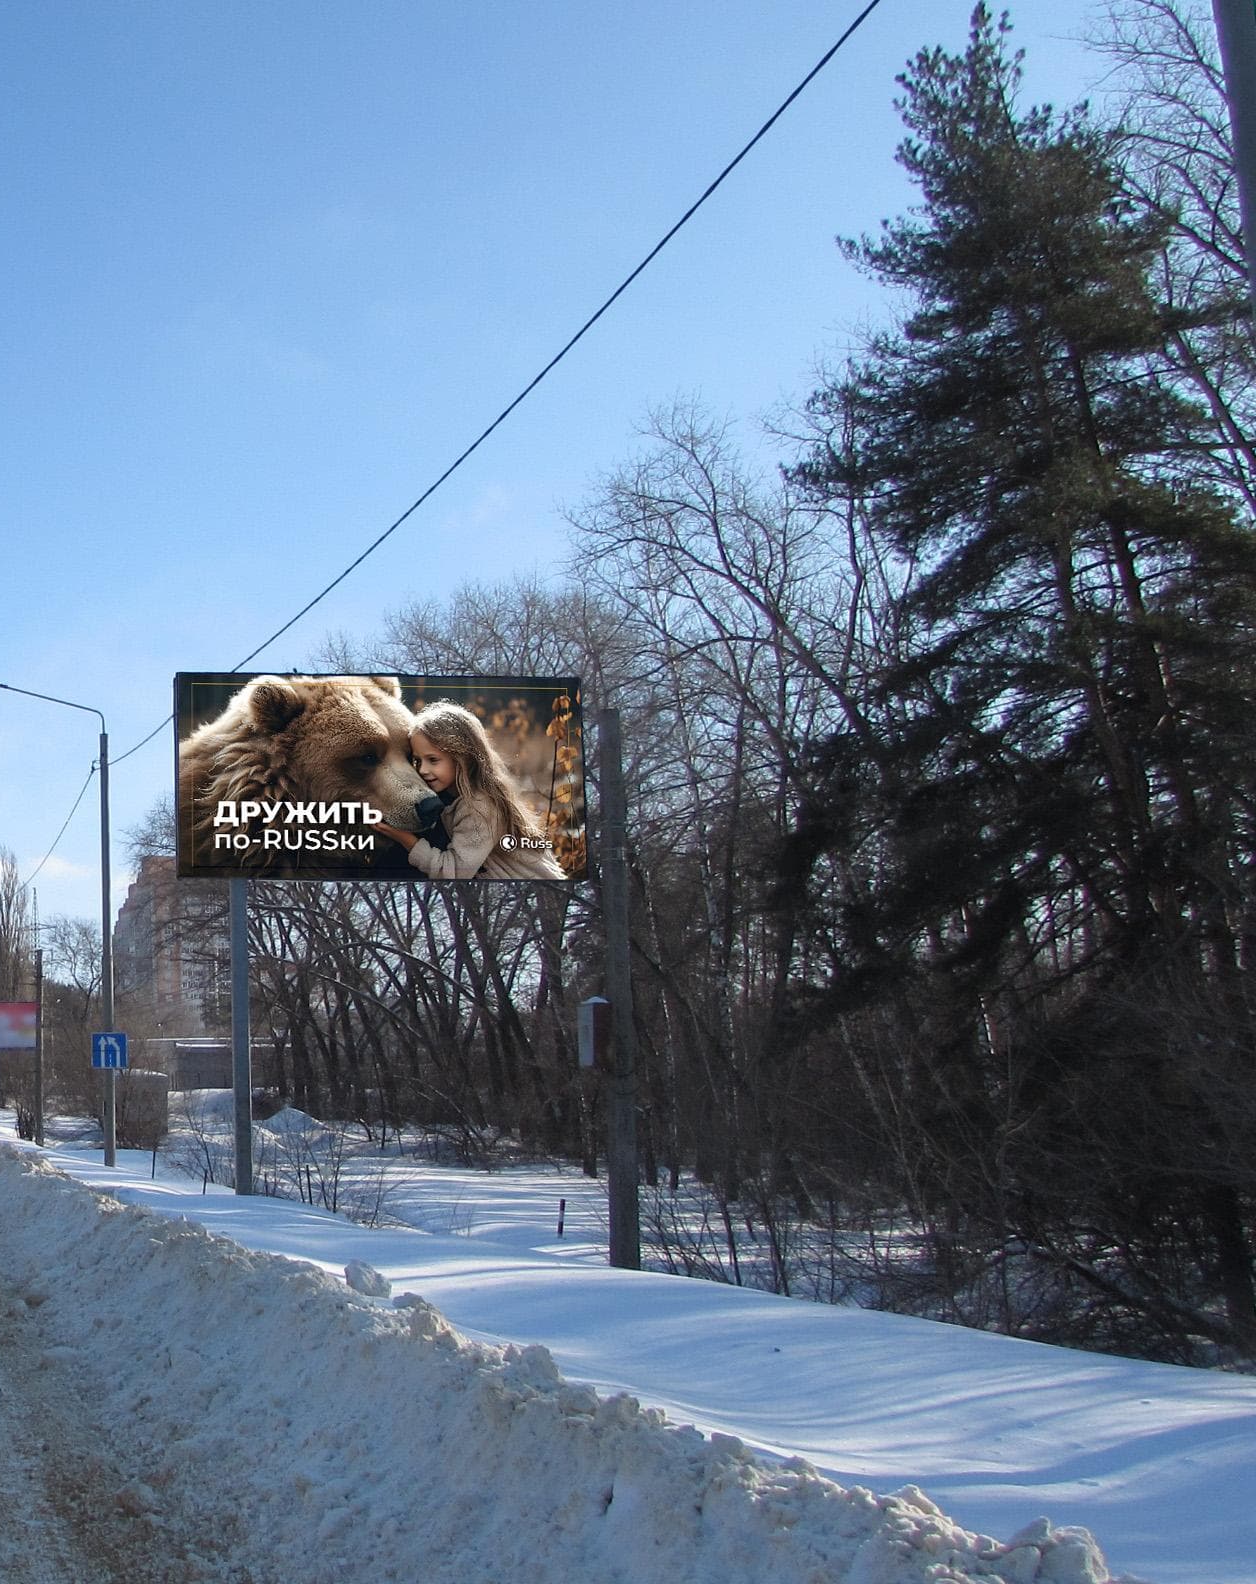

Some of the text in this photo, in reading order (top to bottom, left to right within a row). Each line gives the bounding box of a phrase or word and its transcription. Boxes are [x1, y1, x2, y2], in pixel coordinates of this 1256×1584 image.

[213, 800, 383, 827] ДРУЖИТЬ
[214, 829, 375, 850] по-RUSSки
[520, 837, 553, 849] Russ
